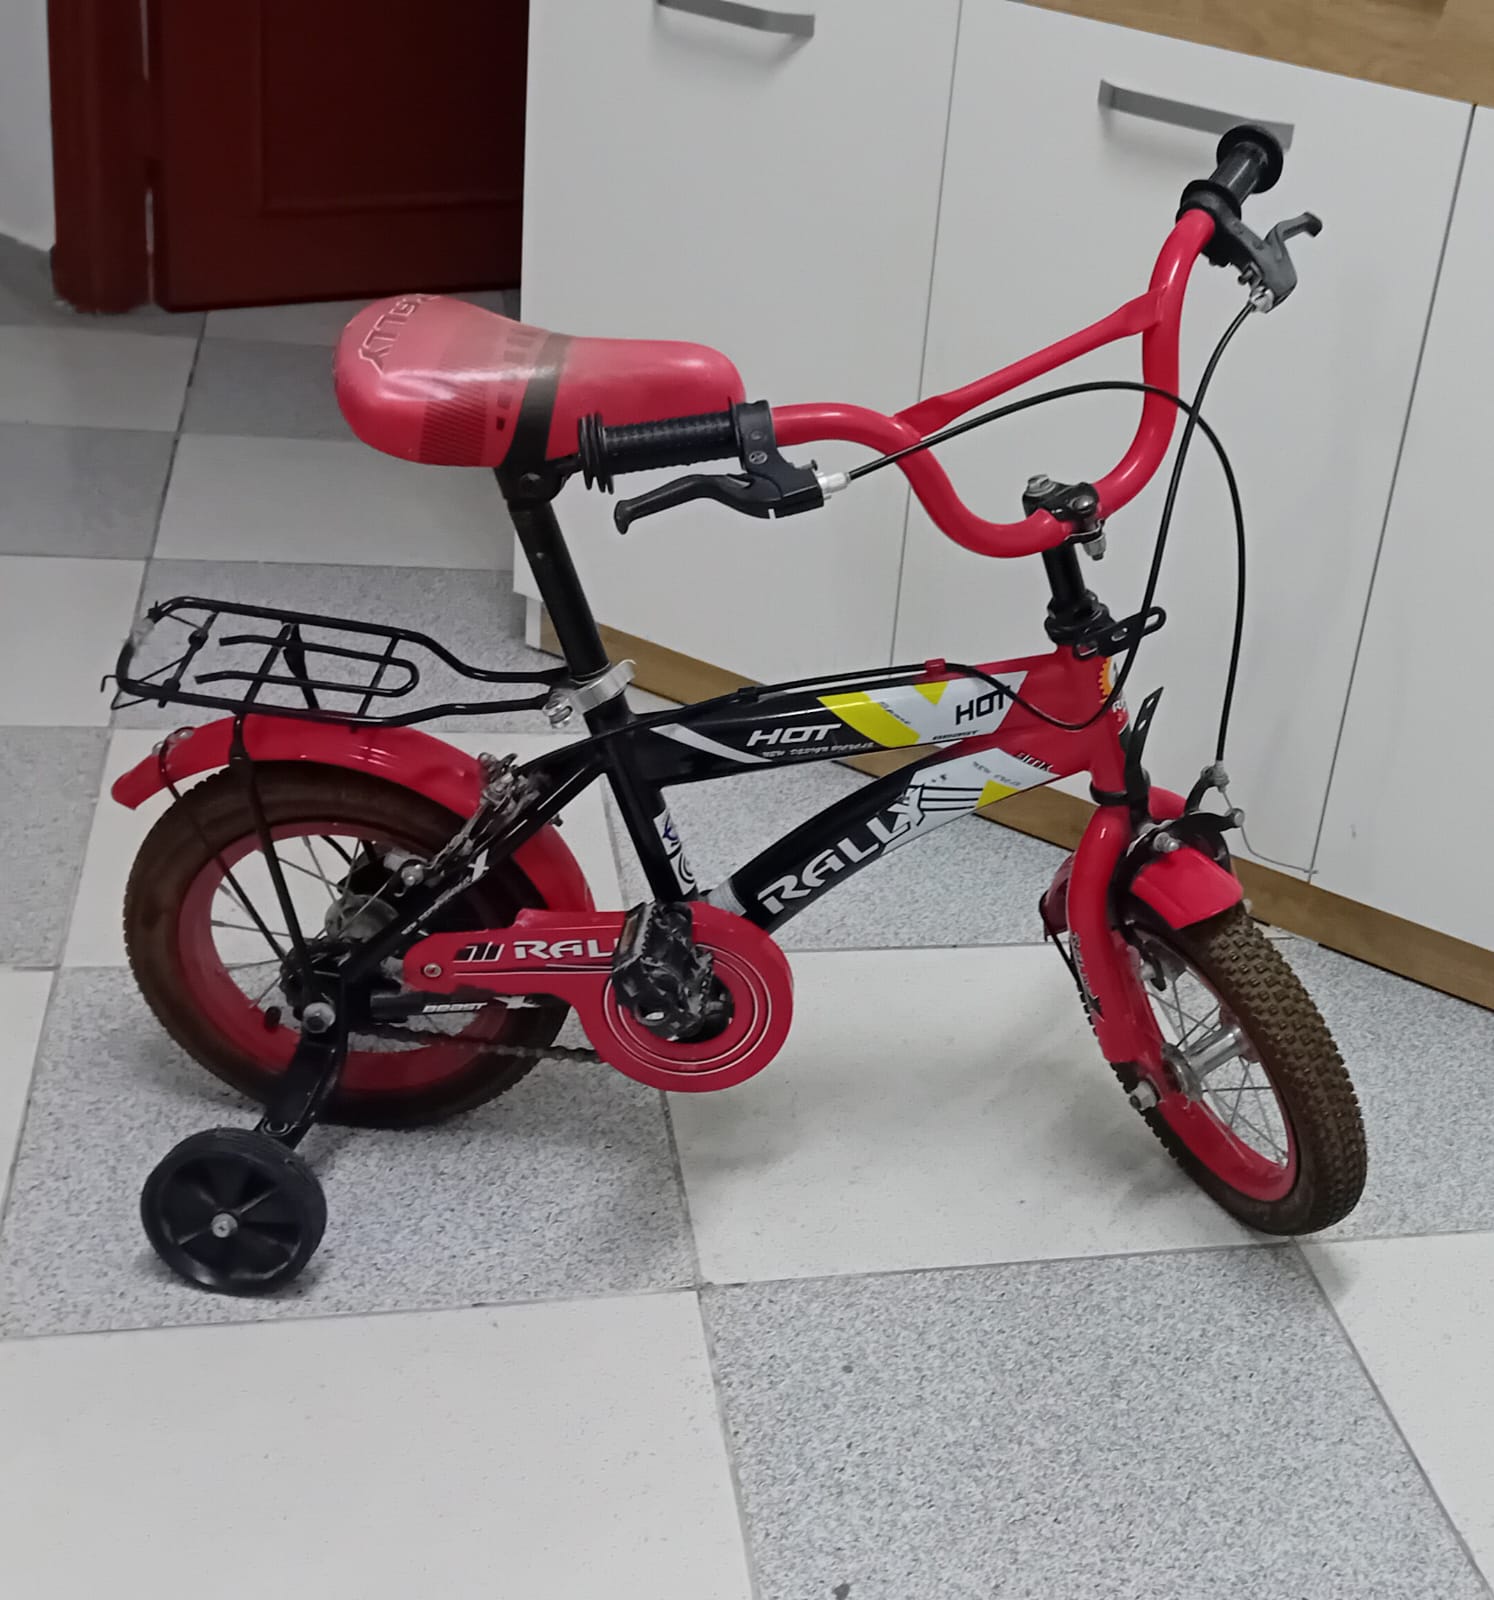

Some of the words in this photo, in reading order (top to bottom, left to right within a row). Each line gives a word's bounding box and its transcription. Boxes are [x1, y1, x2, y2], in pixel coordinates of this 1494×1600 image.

[956, 685, 1011, 726] HOT
[746, 723, 842, 747] HOT
[757, 784, 926, 915] RALLY
[513, 938, 619, 960] RAL
